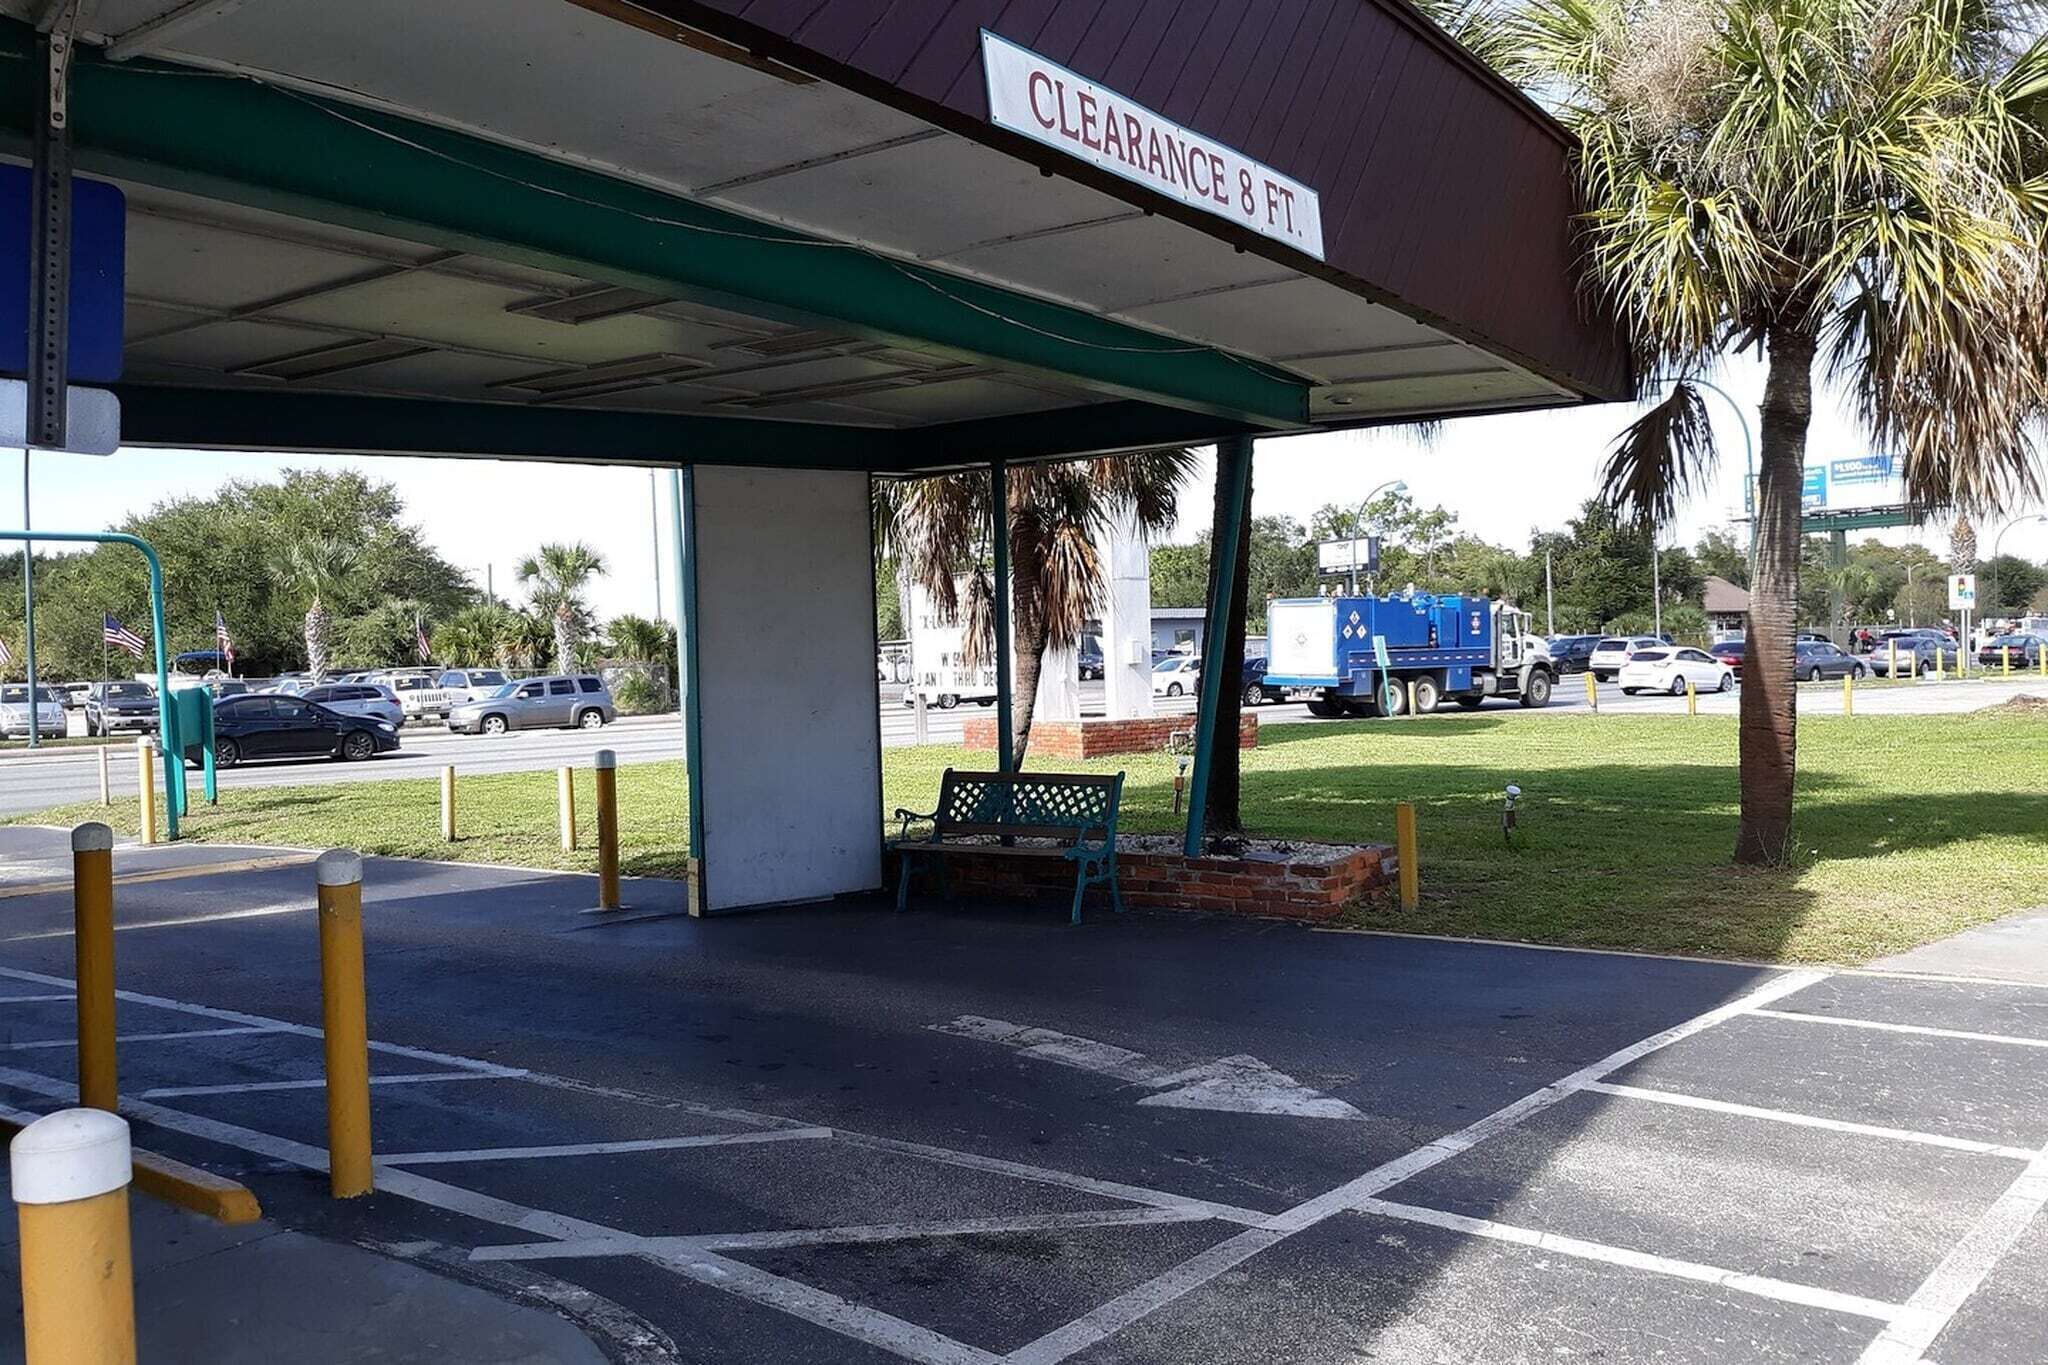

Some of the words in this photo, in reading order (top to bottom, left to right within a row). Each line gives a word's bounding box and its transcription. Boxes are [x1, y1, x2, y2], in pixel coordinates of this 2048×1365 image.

[1028, 71, 1229, 205] CLEARANCE
[1239, 168, 1255, 216] 8
[1264, 179, 1302, 237] FT.
